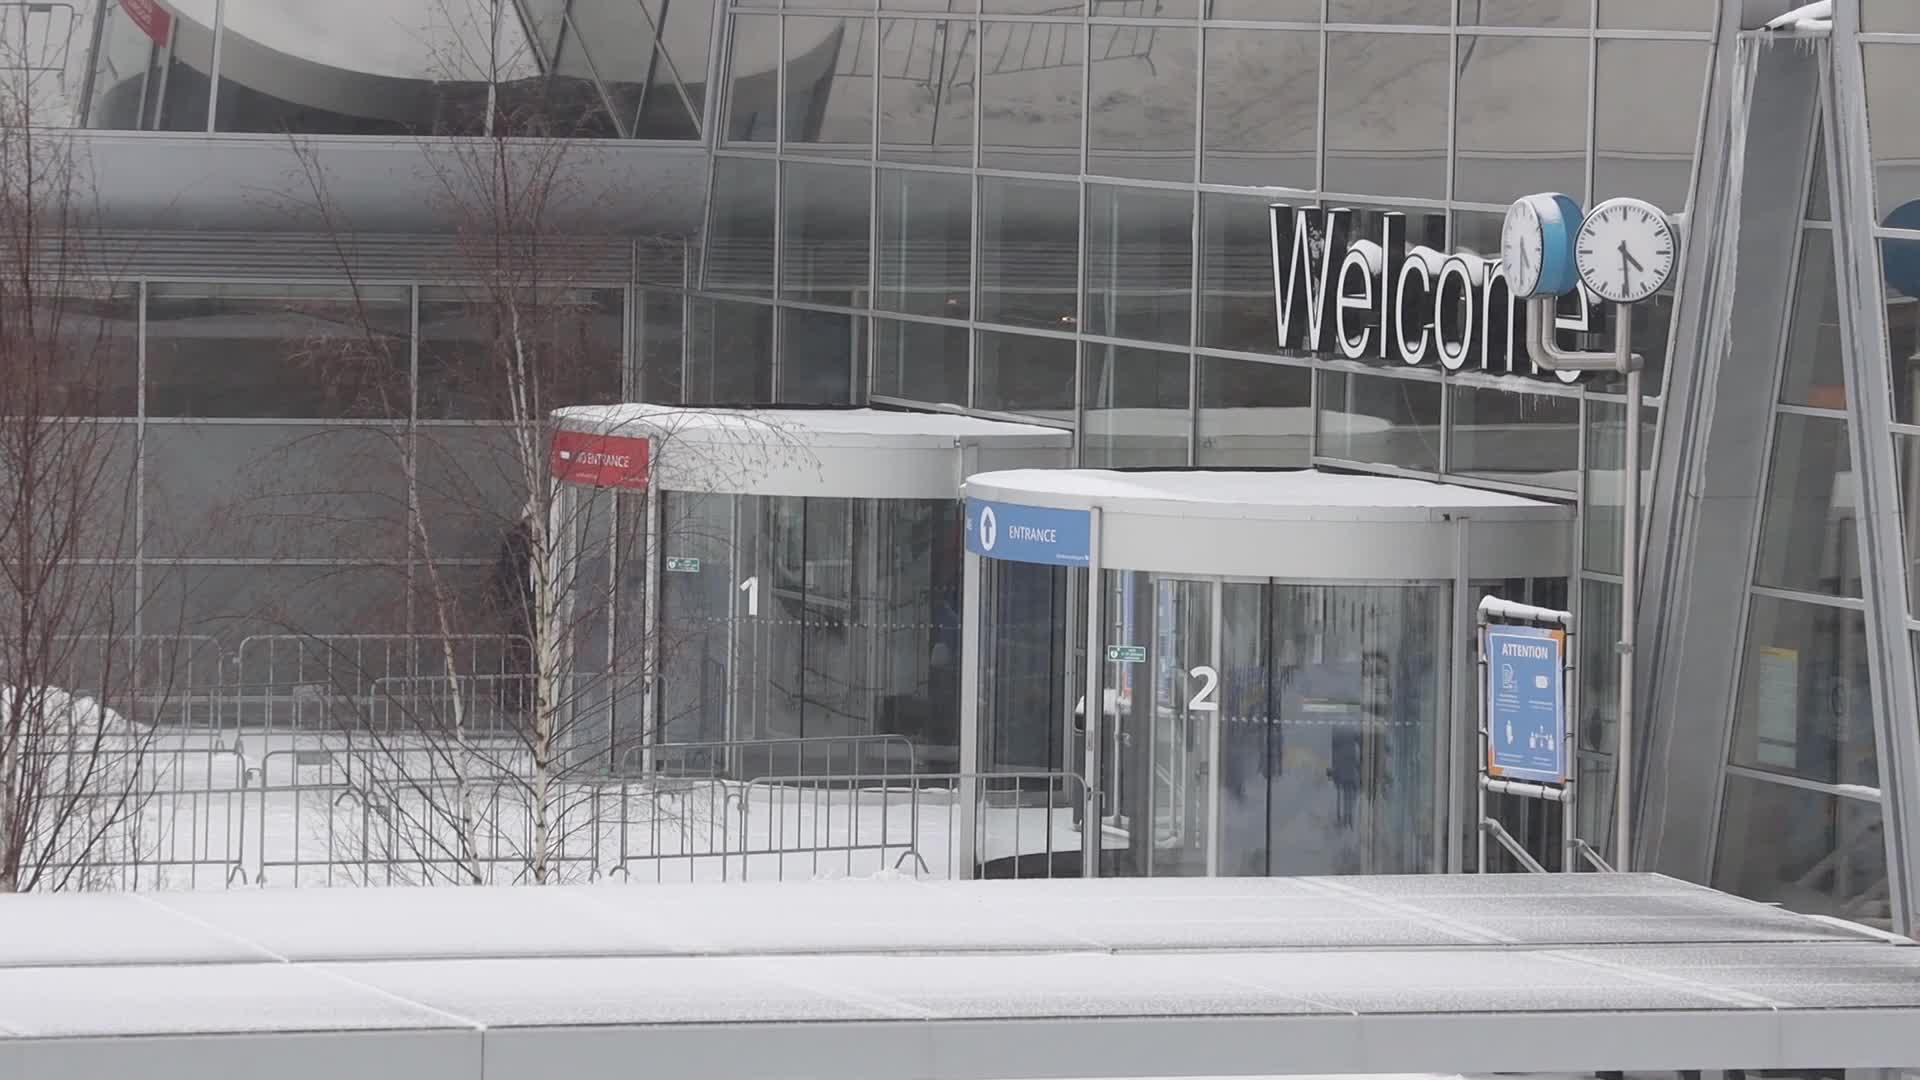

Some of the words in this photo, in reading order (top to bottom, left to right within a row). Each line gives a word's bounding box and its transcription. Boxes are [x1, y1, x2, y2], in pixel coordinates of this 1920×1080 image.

[587, 452, 629, 468] ENTRANCE
[1008, 525, 1057, 543] ENTRANCE
[740, 576, 758, 616] 1
[1502, 643, 1548, 659] ATTENTION
[1188, 666, 1218, 710] 2
